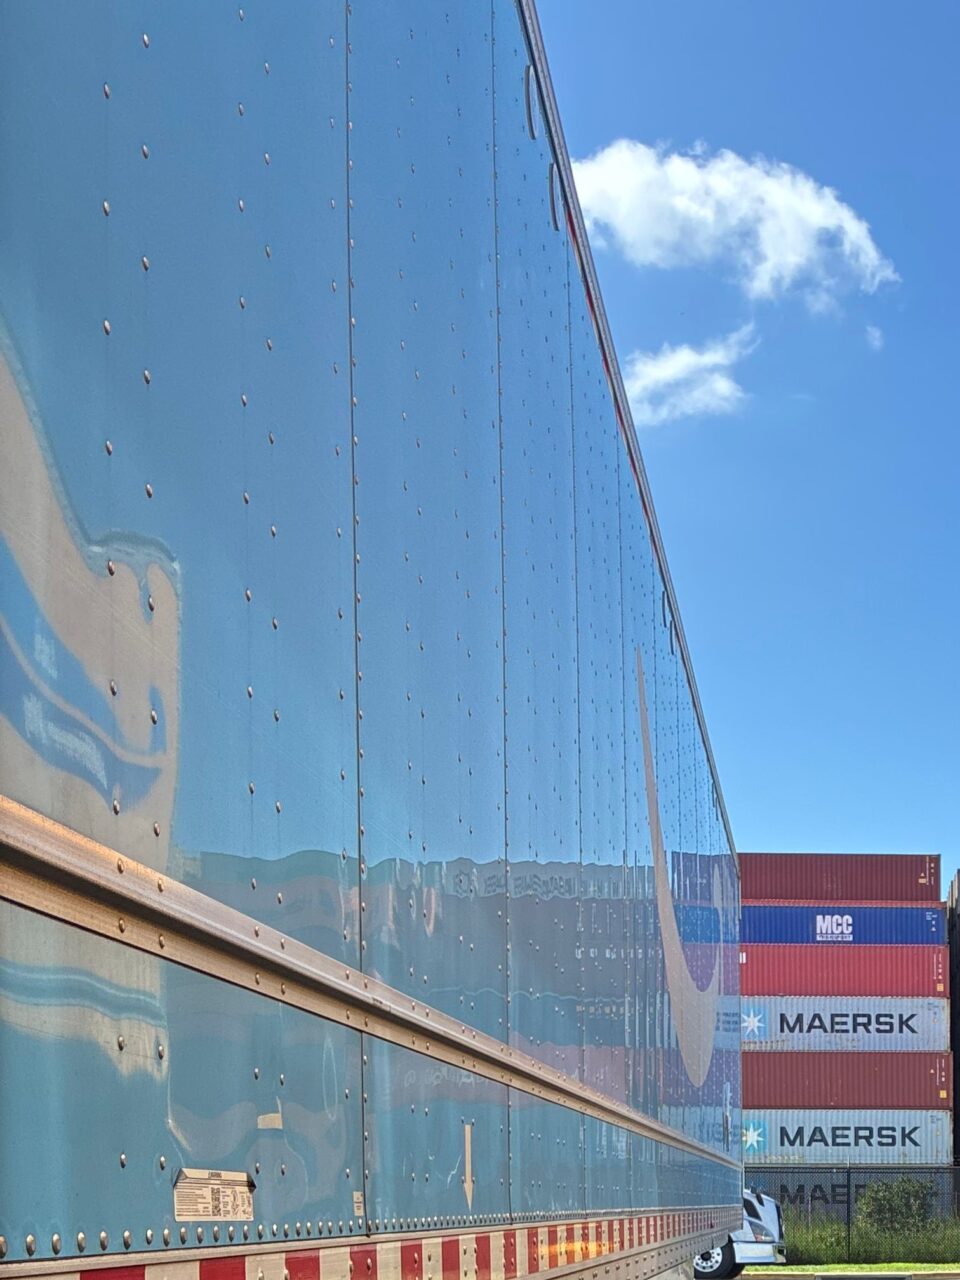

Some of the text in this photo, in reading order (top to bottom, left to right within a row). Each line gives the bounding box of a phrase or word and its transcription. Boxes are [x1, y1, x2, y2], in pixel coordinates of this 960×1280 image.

[816, 914, 853, 934] MCC
[779, 1012, 919, 1034] MAERSK
[779, 1126, 921, 1147] MAERSK
[779, 1184, 868, 1205] MAE
